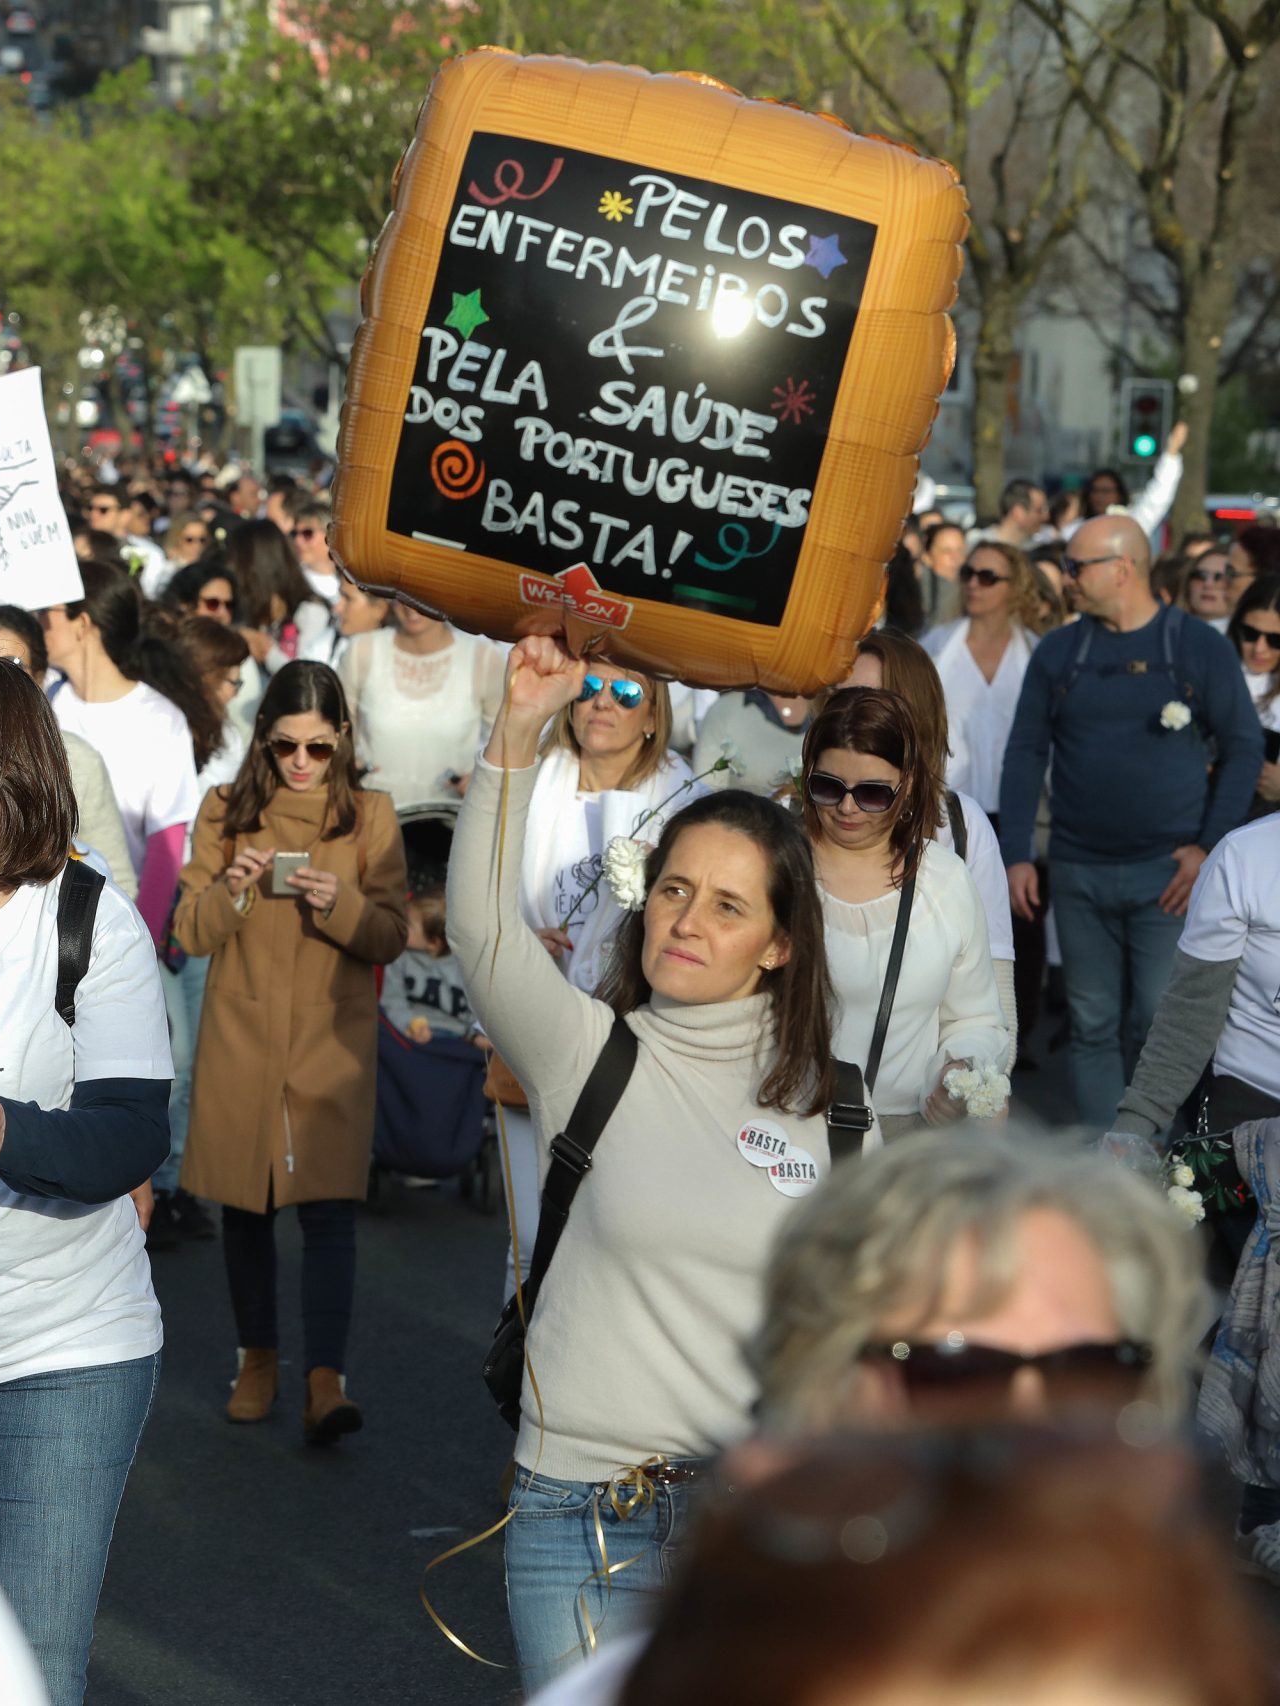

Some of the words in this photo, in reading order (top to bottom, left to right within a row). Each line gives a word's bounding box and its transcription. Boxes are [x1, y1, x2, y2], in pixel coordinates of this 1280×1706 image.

[628, 174, 808, 270] PELOS
[587, 295, 665, 375] &
[421, 326, 549, 411] PELA
[589, 380, 778, 460] SAÚDE
[404, 385, 485, 443] DOS
[513, 416, 812, 529] PORTUGUESES
[481, 478, 694, 579] BASTA!
